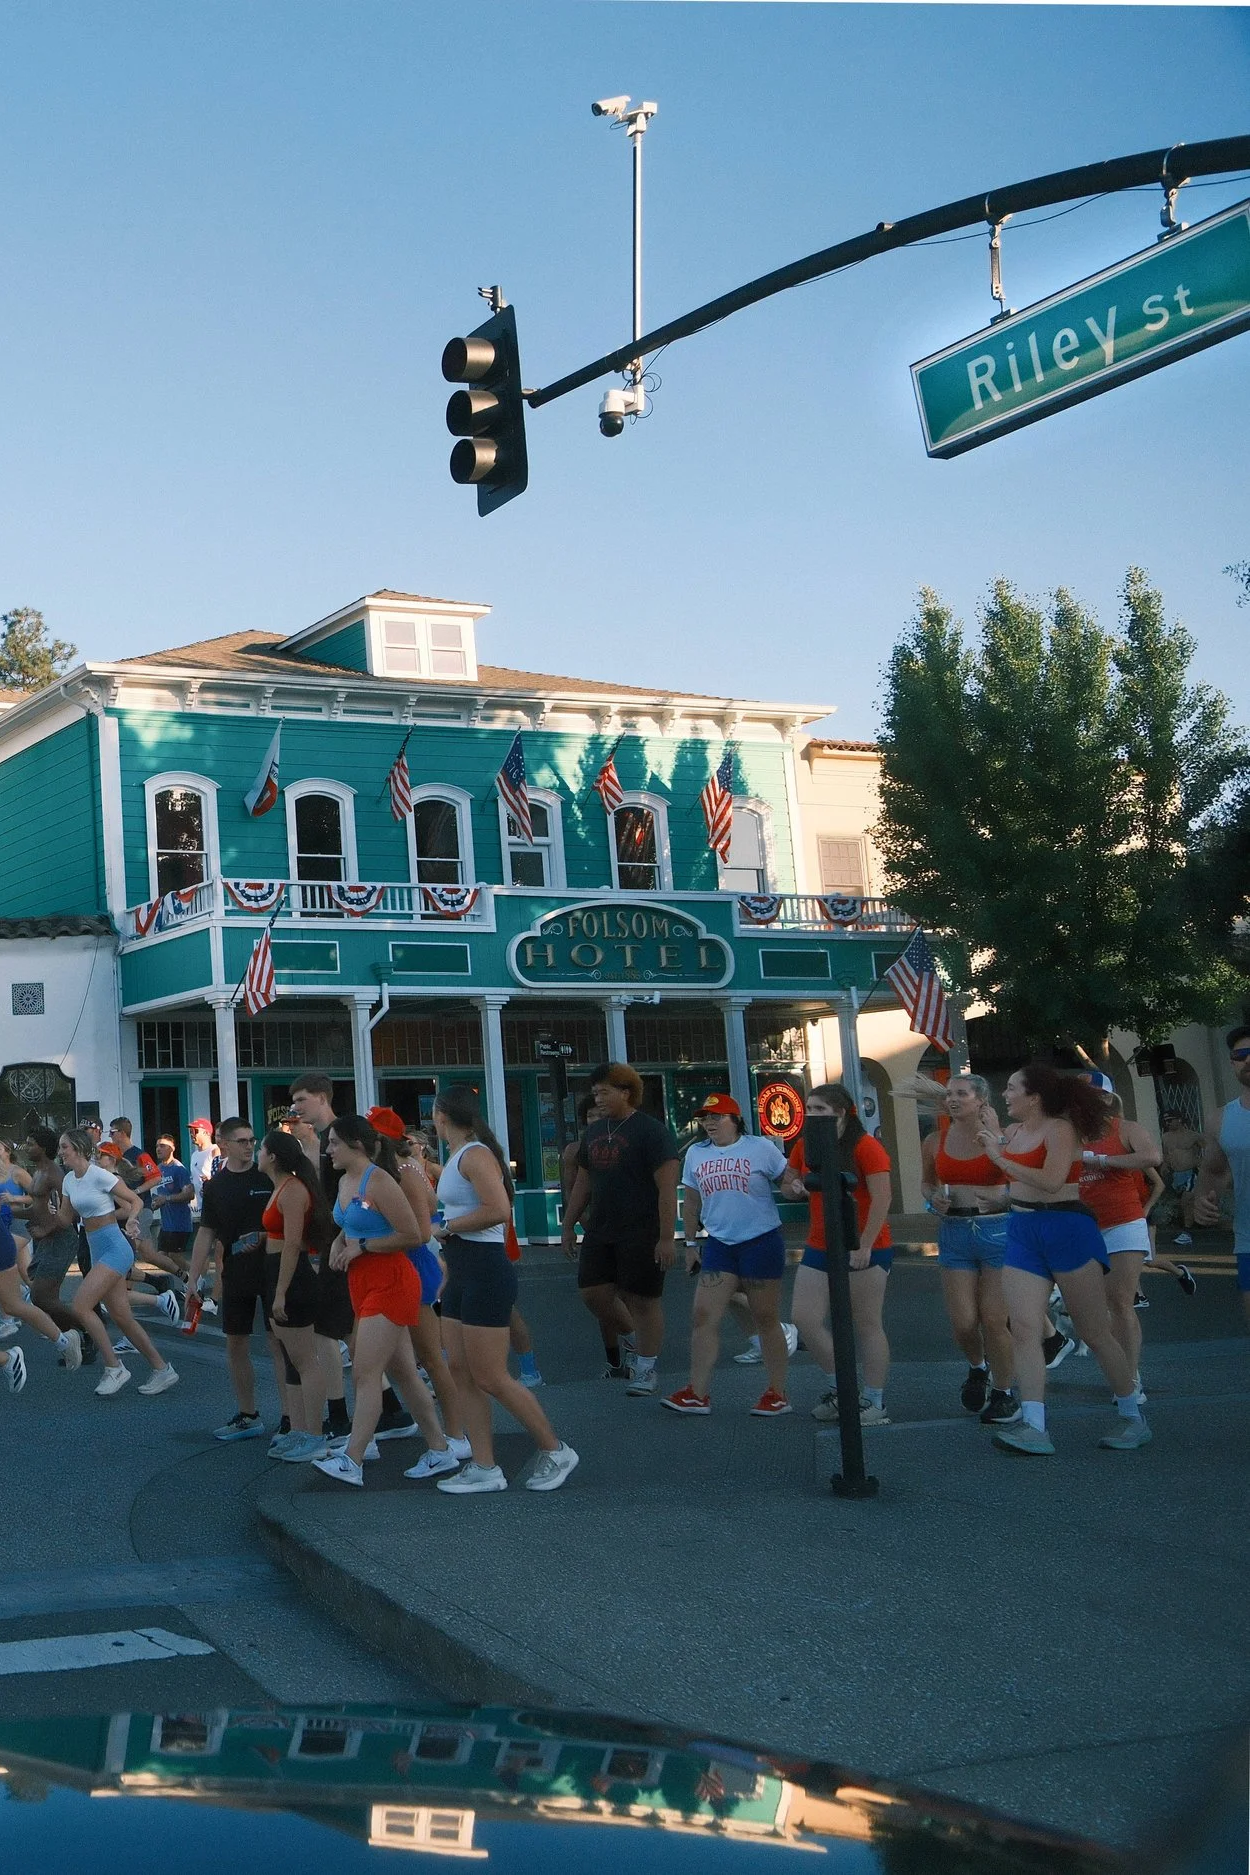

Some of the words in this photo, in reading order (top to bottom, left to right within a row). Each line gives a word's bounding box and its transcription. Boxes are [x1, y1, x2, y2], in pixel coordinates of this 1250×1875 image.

[967, 305, 1117, 411] Riley
[568, 911, 670, 939] FOLSOM
[525, 943, 720, 969] HOTEL
[759, 1090, 772, 1113] SUGAR
[694, 1157, 751, 1179] AMERICA'S
